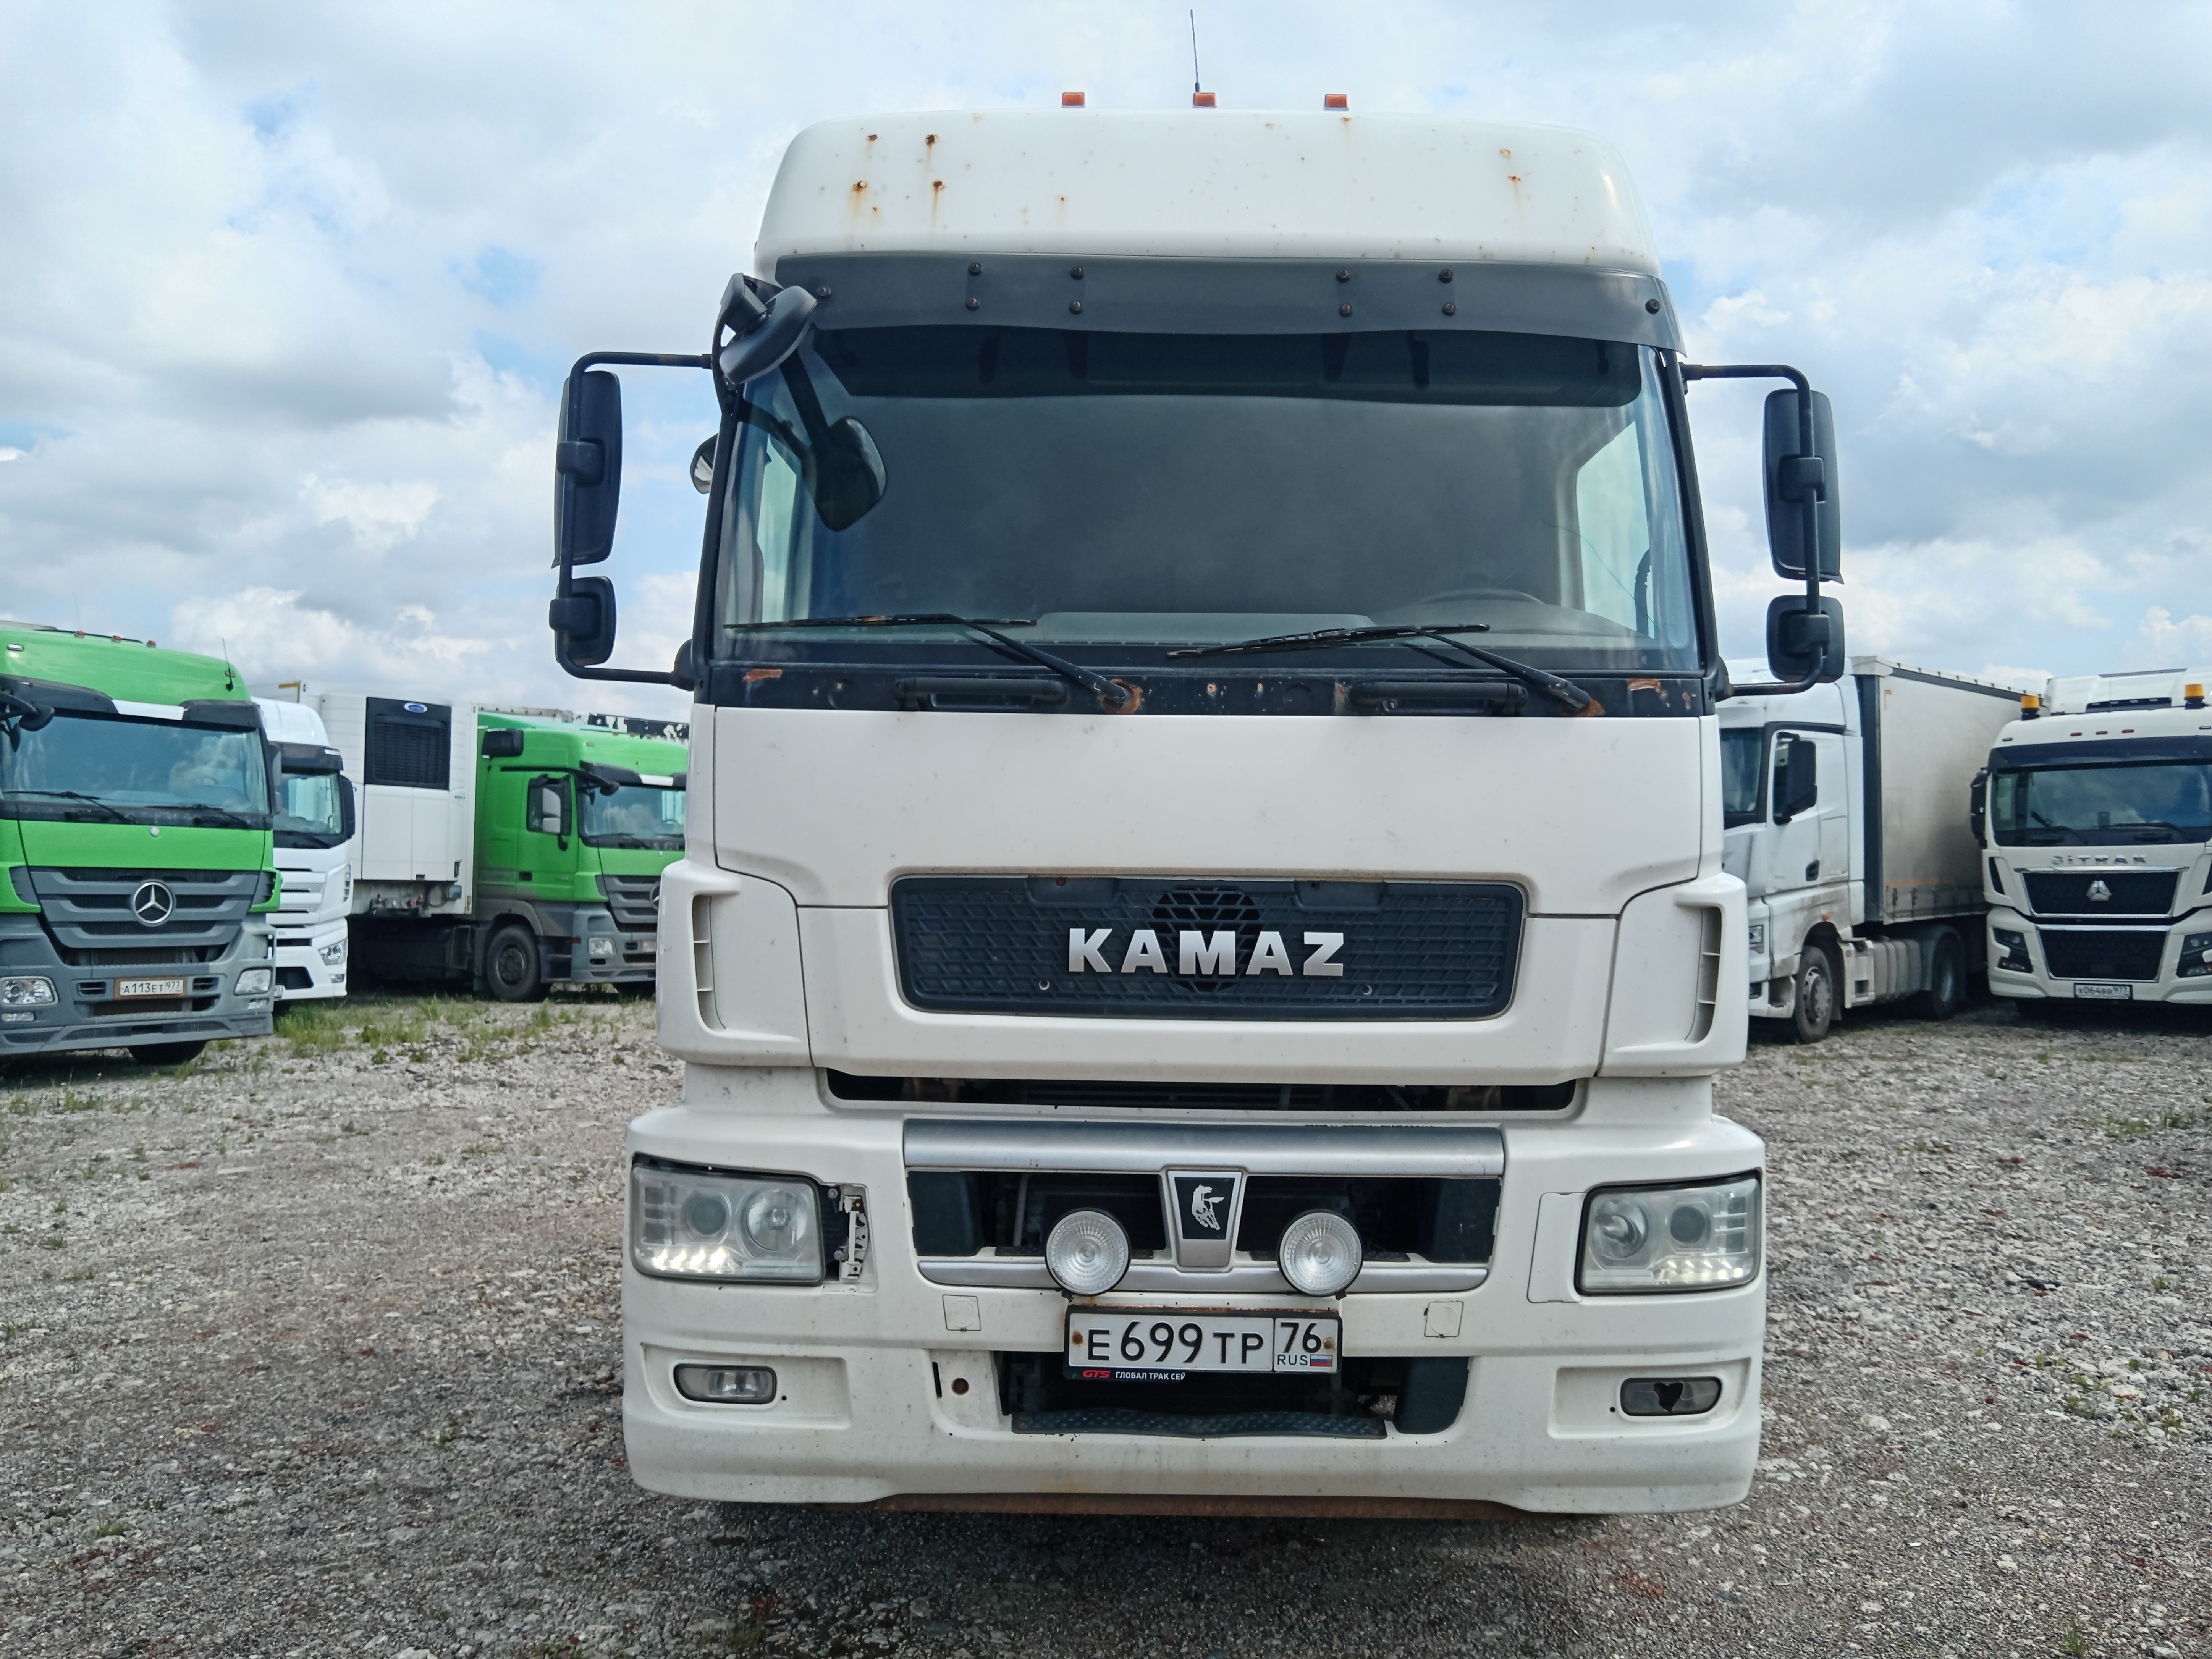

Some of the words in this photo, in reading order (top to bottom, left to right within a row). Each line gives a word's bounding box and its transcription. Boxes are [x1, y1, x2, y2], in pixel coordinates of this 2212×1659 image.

[1069, 928, 1344, 976] KAMAZ
[1281, 1322, 1322, 1353] 76
[1277, 1354, 1308, 1366] RUS
[1083, 1370, 1111, 1378] GTS
[1115, 1371, 1147, 1379] ГЛОБАЛ
[1149, 1372, 1169, 1380] ТРАК
